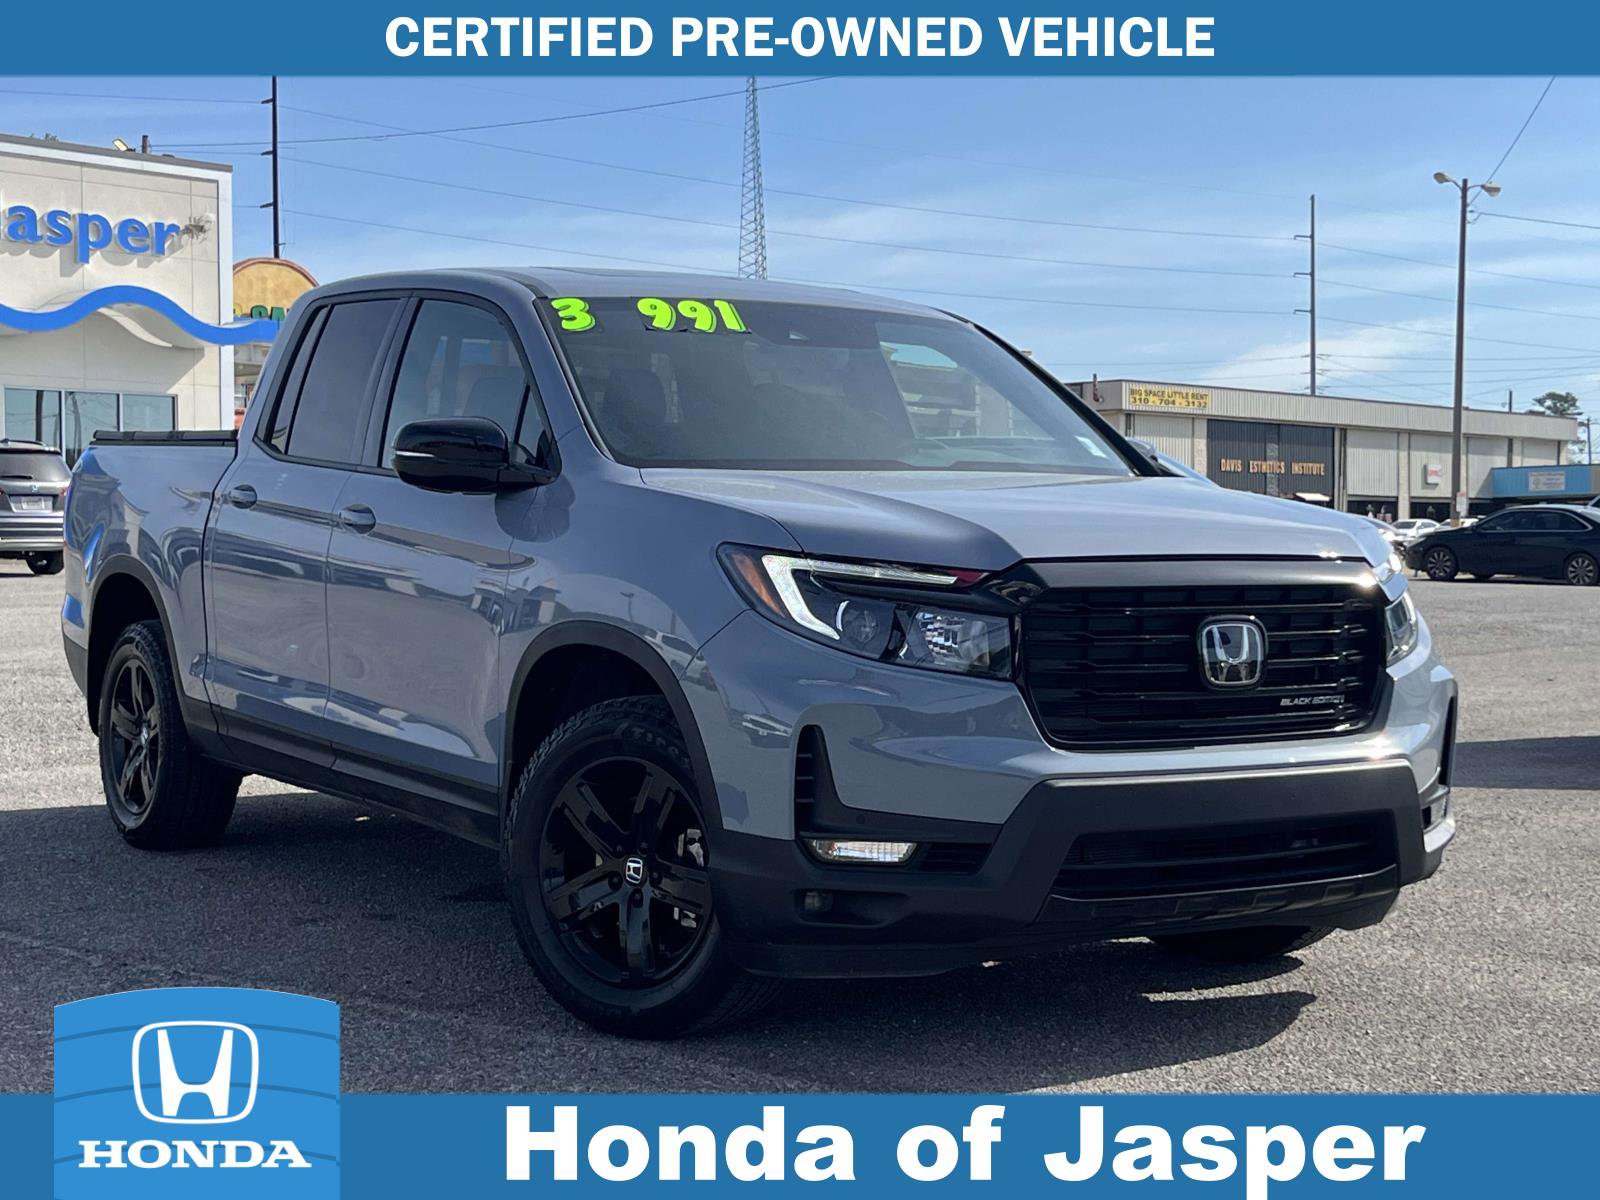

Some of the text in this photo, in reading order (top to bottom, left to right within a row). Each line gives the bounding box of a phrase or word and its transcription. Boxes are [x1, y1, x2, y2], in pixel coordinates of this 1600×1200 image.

[1, 205, 181, 264] asper
[550, 297, 747, 332] 3 991
[1130, 388, 1209, 400] BIG SPACE LITTLE RENT
[1220, 458, 1242, 472] DAVIS
[1291, 462, 1325, 476] INSTITUTE
[1280, 697, 1312, 706] BLACK
